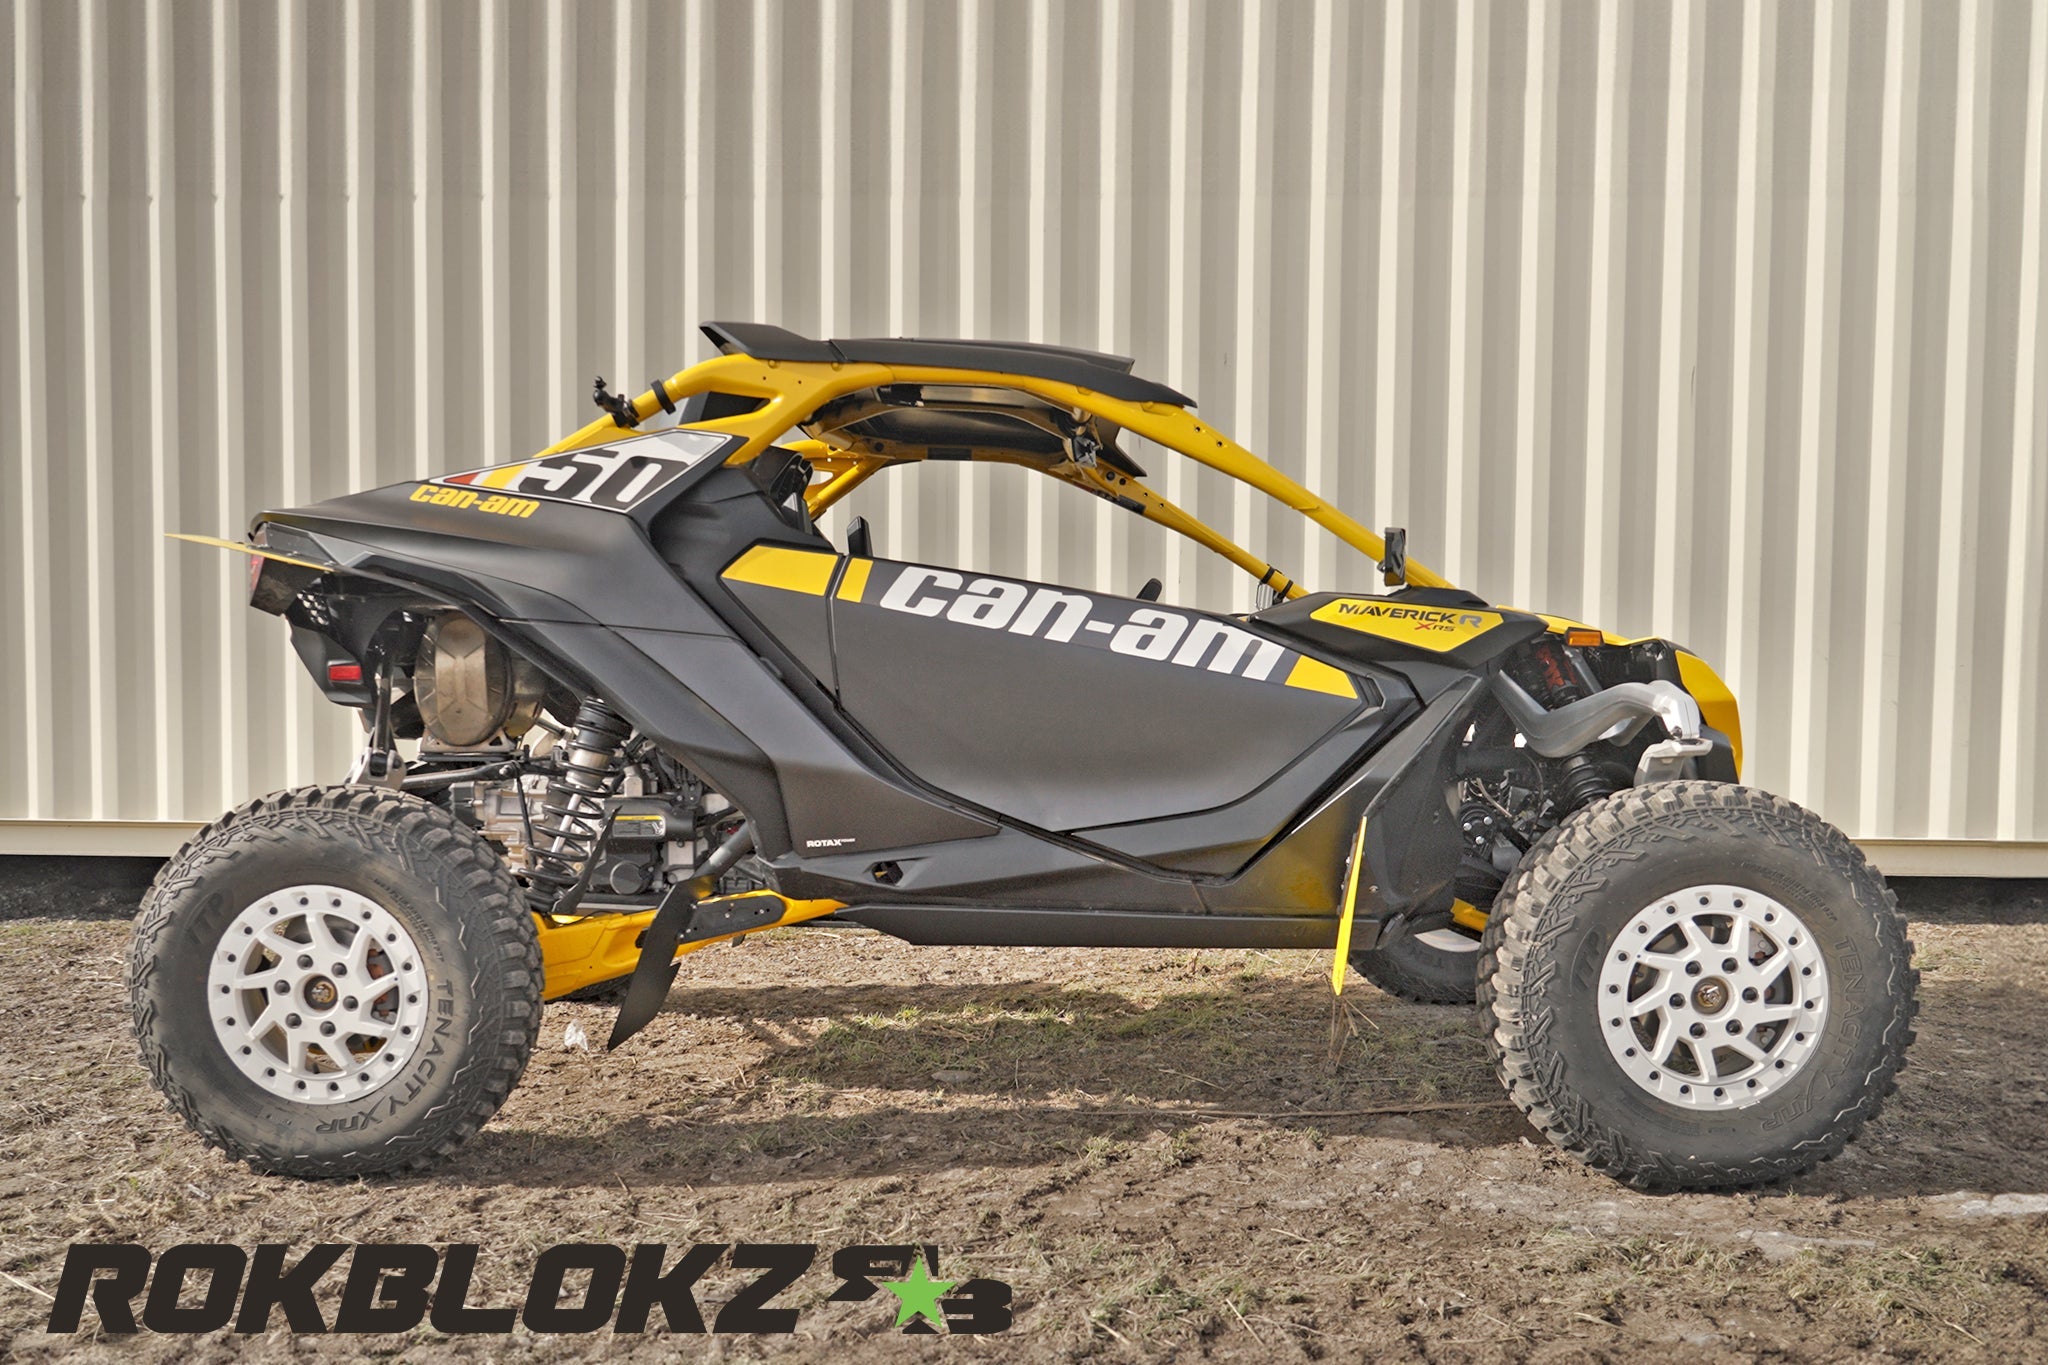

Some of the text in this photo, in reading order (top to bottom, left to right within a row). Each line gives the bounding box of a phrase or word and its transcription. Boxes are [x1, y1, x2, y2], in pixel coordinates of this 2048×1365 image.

[409, 484, 541, 519] can-am
[518, 447, 691, 509] 50
[879, 566, 1287, 682] can-am
[1338, 603, 1484, 628] MAVERICK R
[806, 839, 842, 848] ROTAX
[1825, 936, 1866, 1090] TENACITY
[388, 979, 454, 1116] TENACITY
